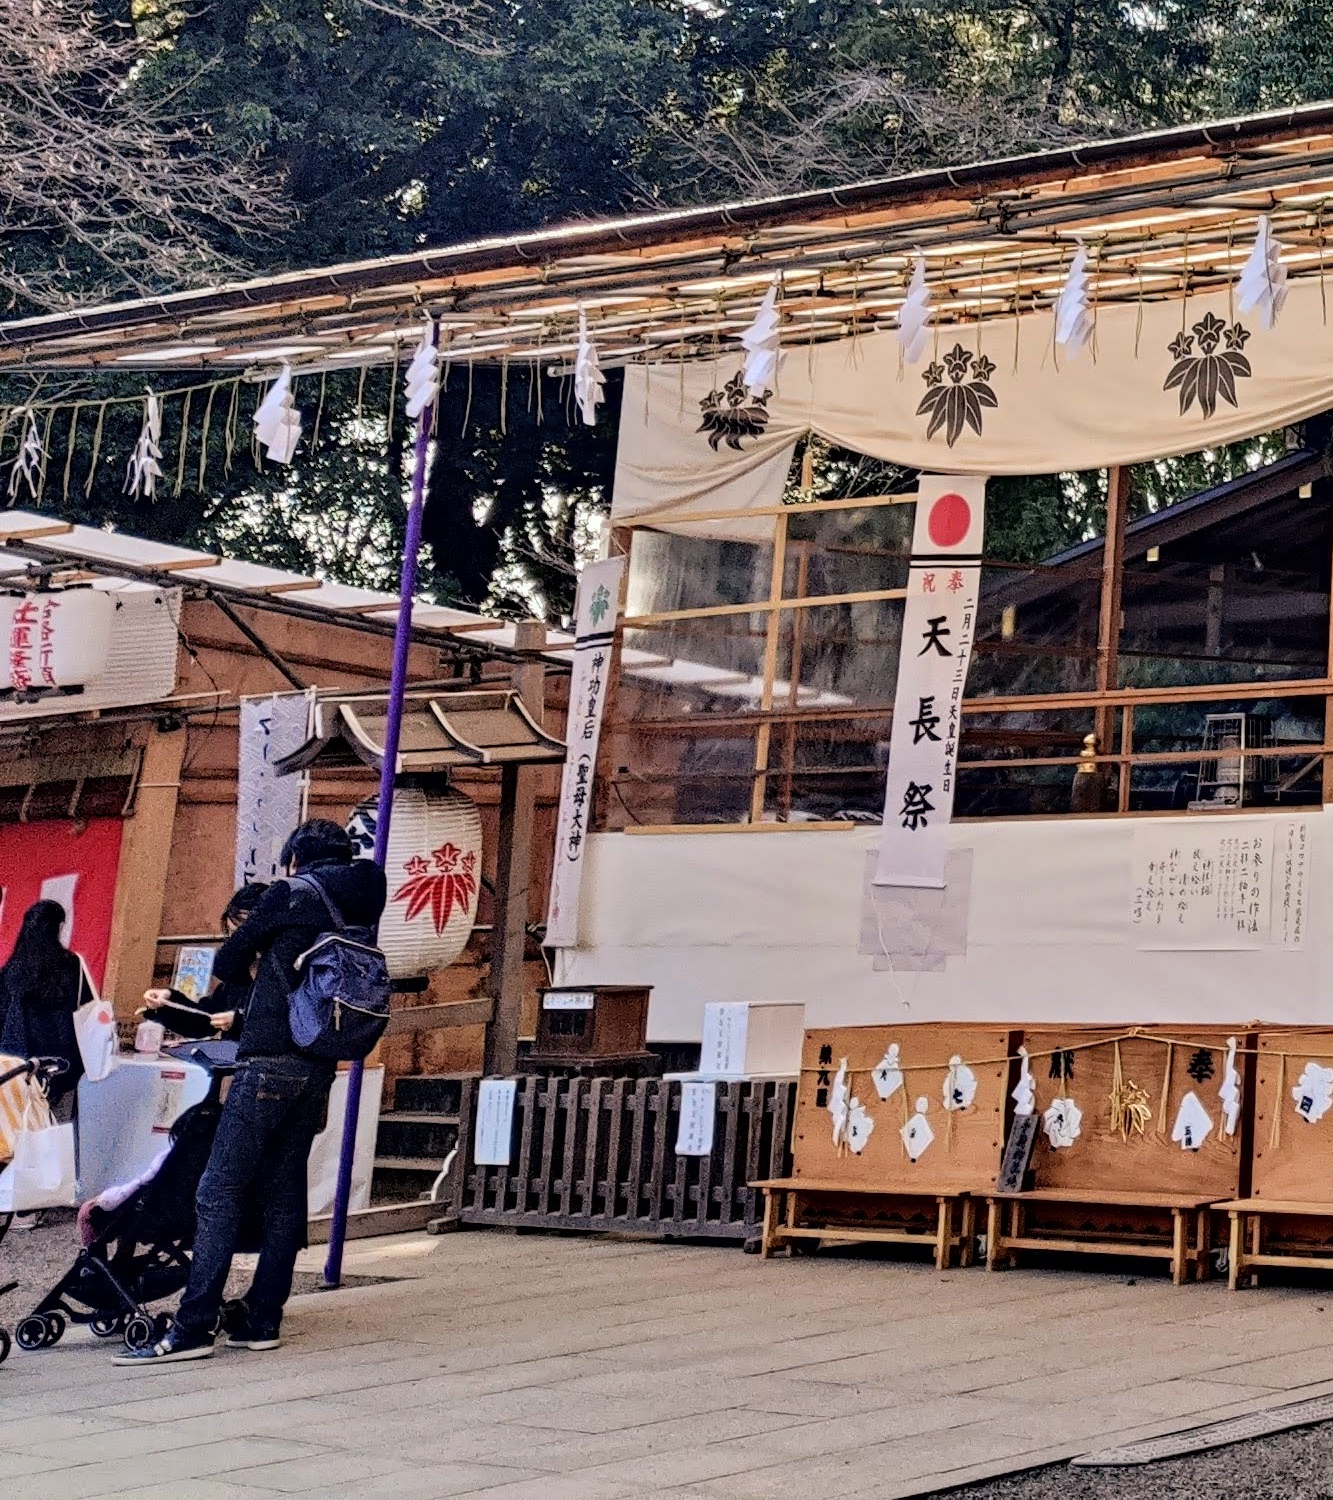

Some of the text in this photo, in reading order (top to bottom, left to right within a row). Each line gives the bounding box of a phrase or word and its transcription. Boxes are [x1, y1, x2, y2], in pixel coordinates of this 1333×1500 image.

[899, 615, 954, 831] 天長祭
[943, 598, 974, 792] 二月二十三日天皇誕生日
